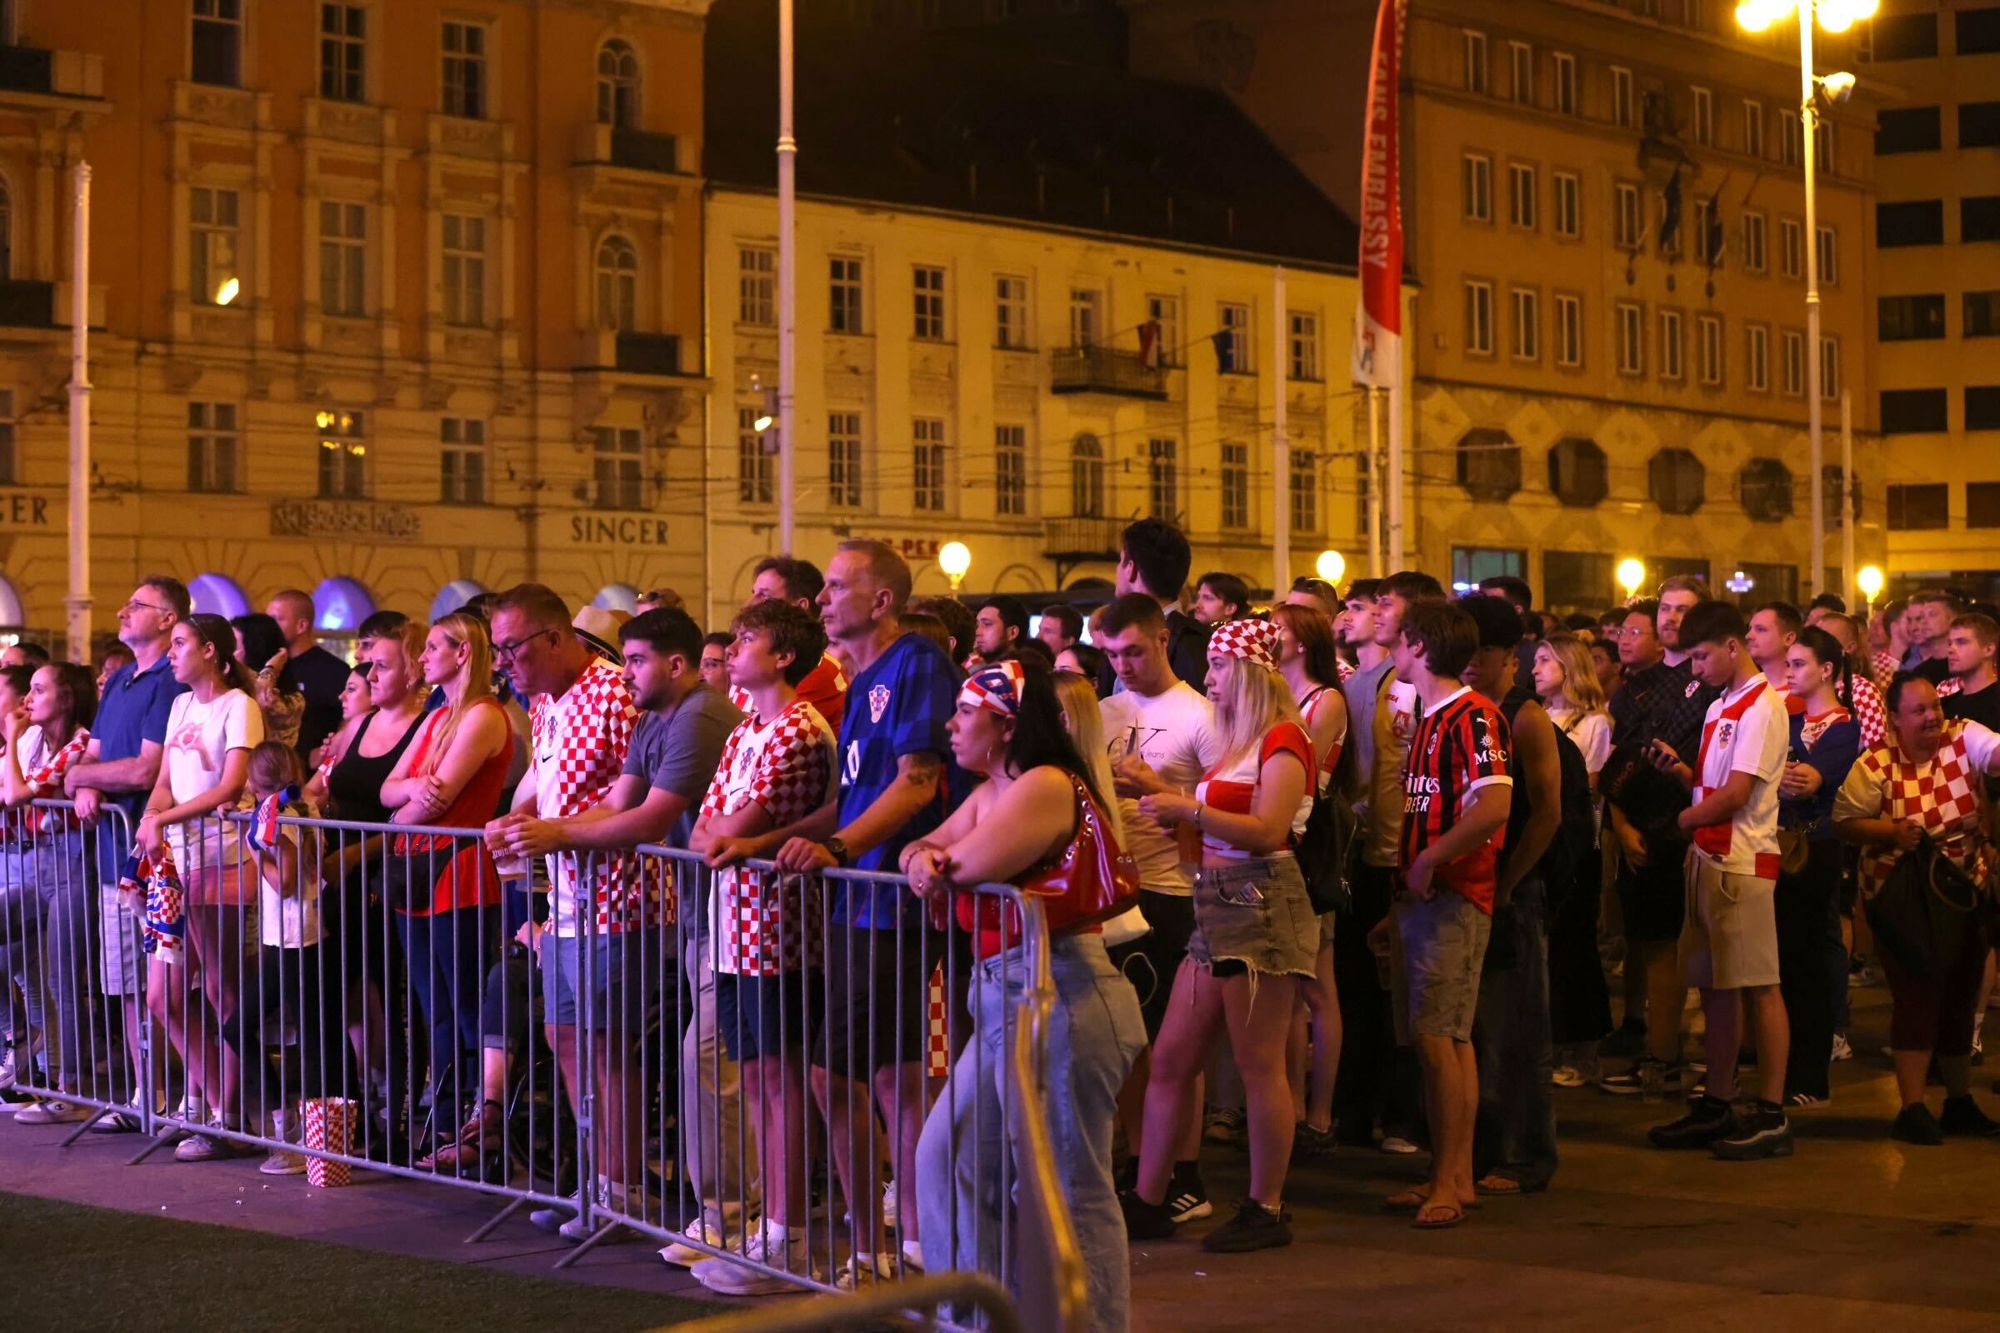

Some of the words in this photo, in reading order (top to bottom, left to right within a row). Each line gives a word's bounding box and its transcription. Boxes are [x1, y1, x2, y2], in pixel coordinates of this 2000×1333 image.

[0, 494, 48, 525] ER
[571, 516, 668, 545] SINGER
[1474, 749, 1508, 766] MSC
[1404, 796, 1430, 813] BEER
